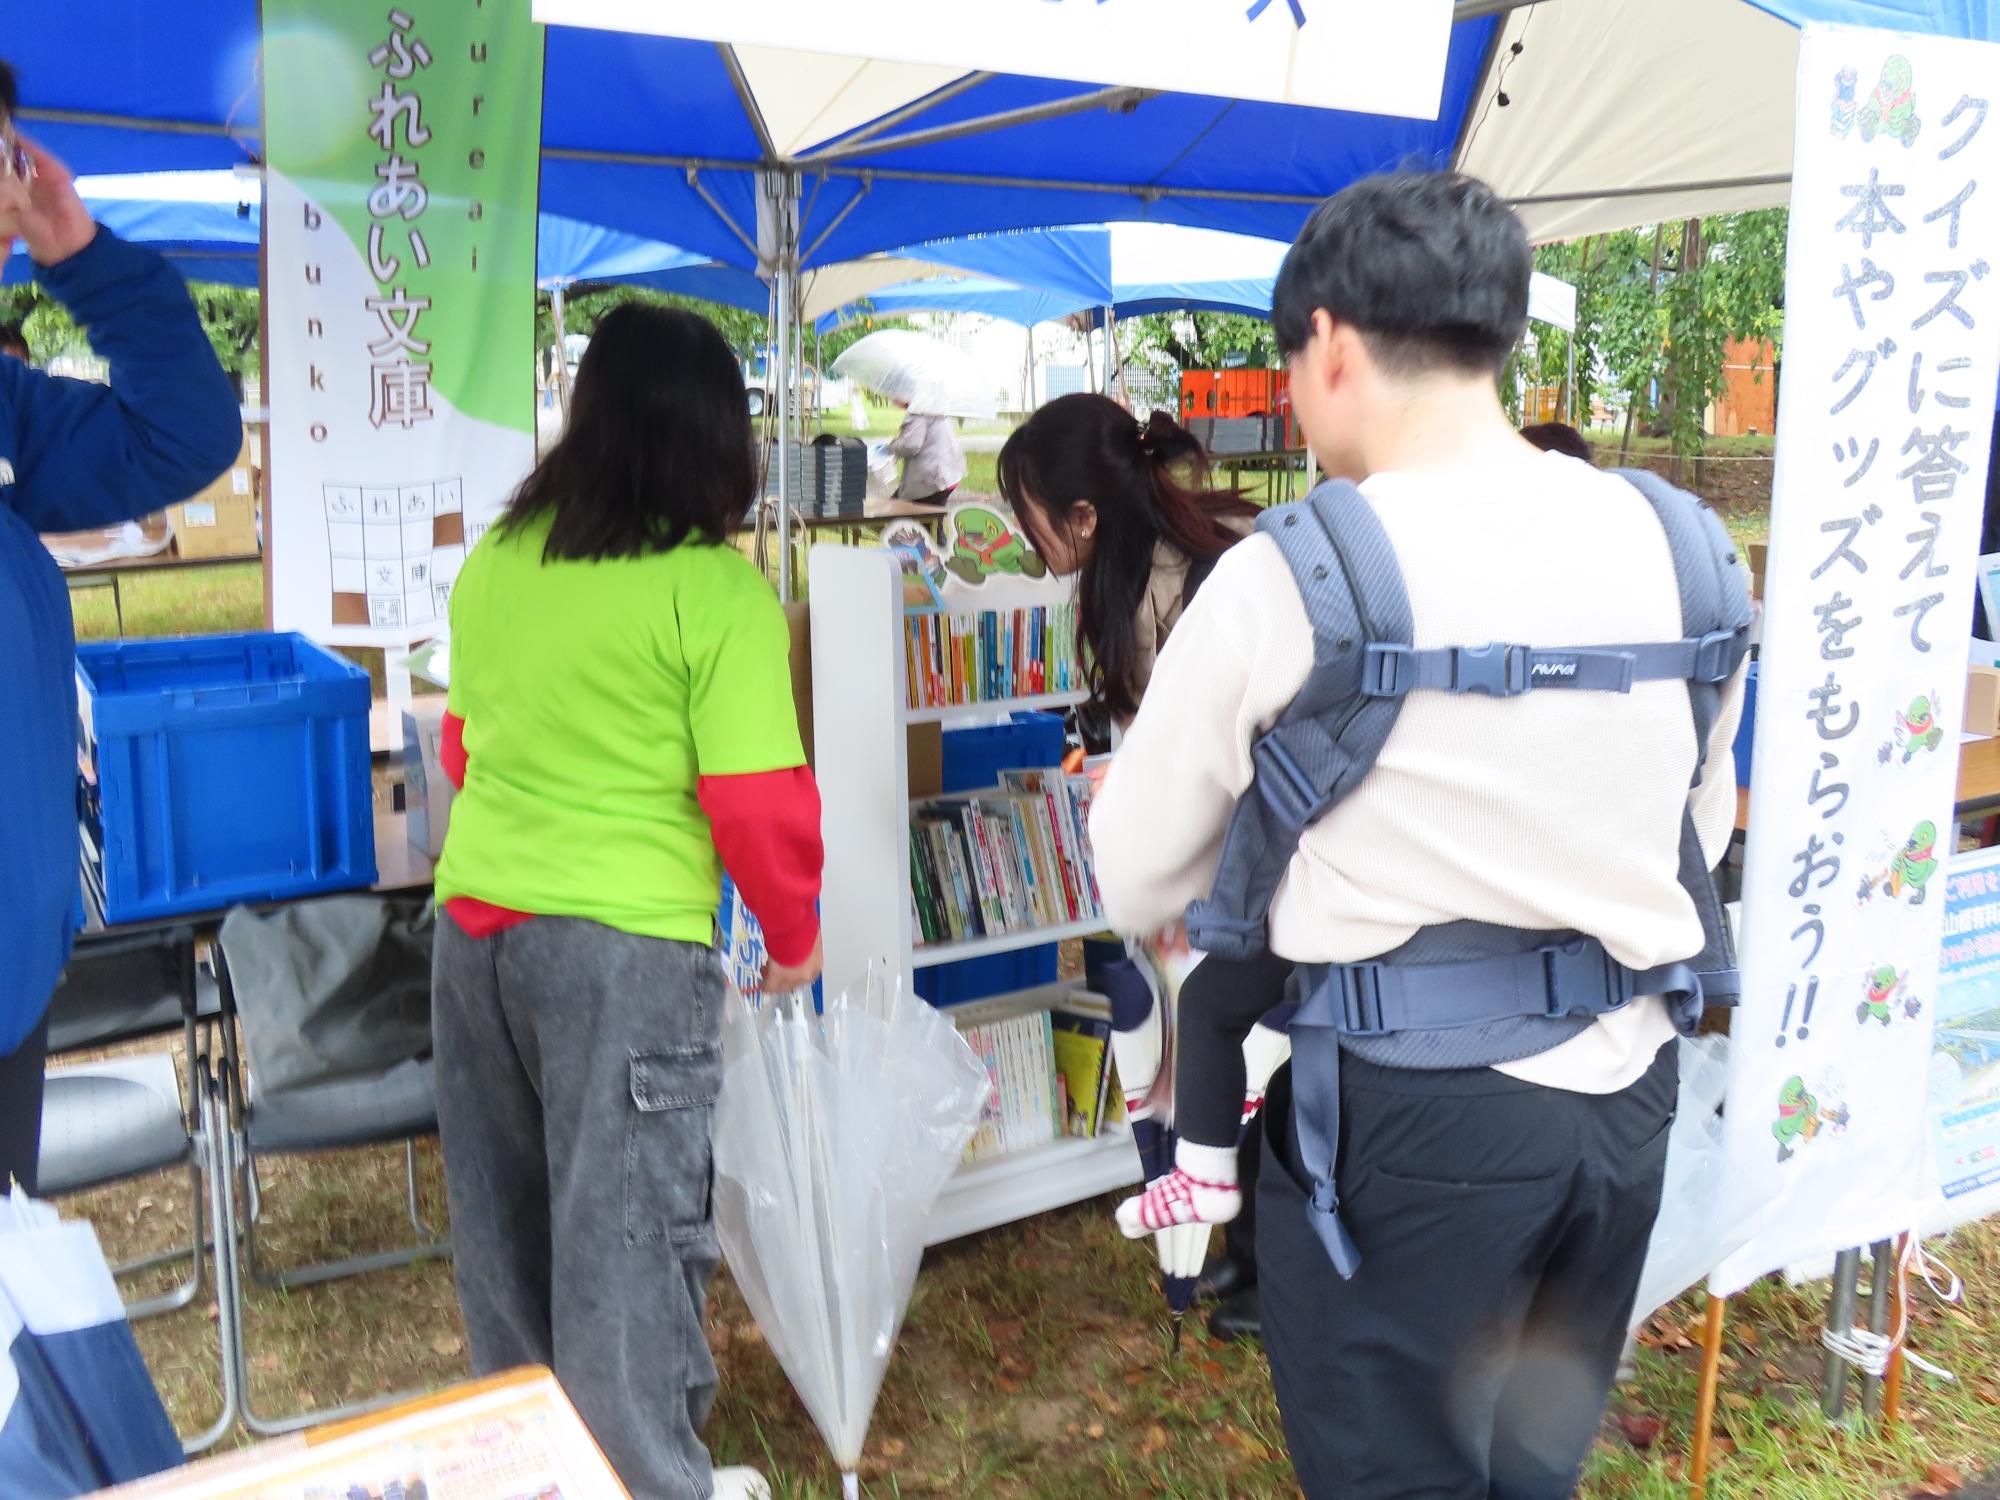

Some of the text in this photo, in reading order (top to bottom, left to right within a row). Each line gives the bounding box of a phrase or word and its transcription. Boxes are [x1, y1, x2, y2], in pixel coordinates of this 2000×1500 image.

[365, 8, 434, 429] ふれあい文庫
[1893, 93, 1990, 654] クイズに答えて
